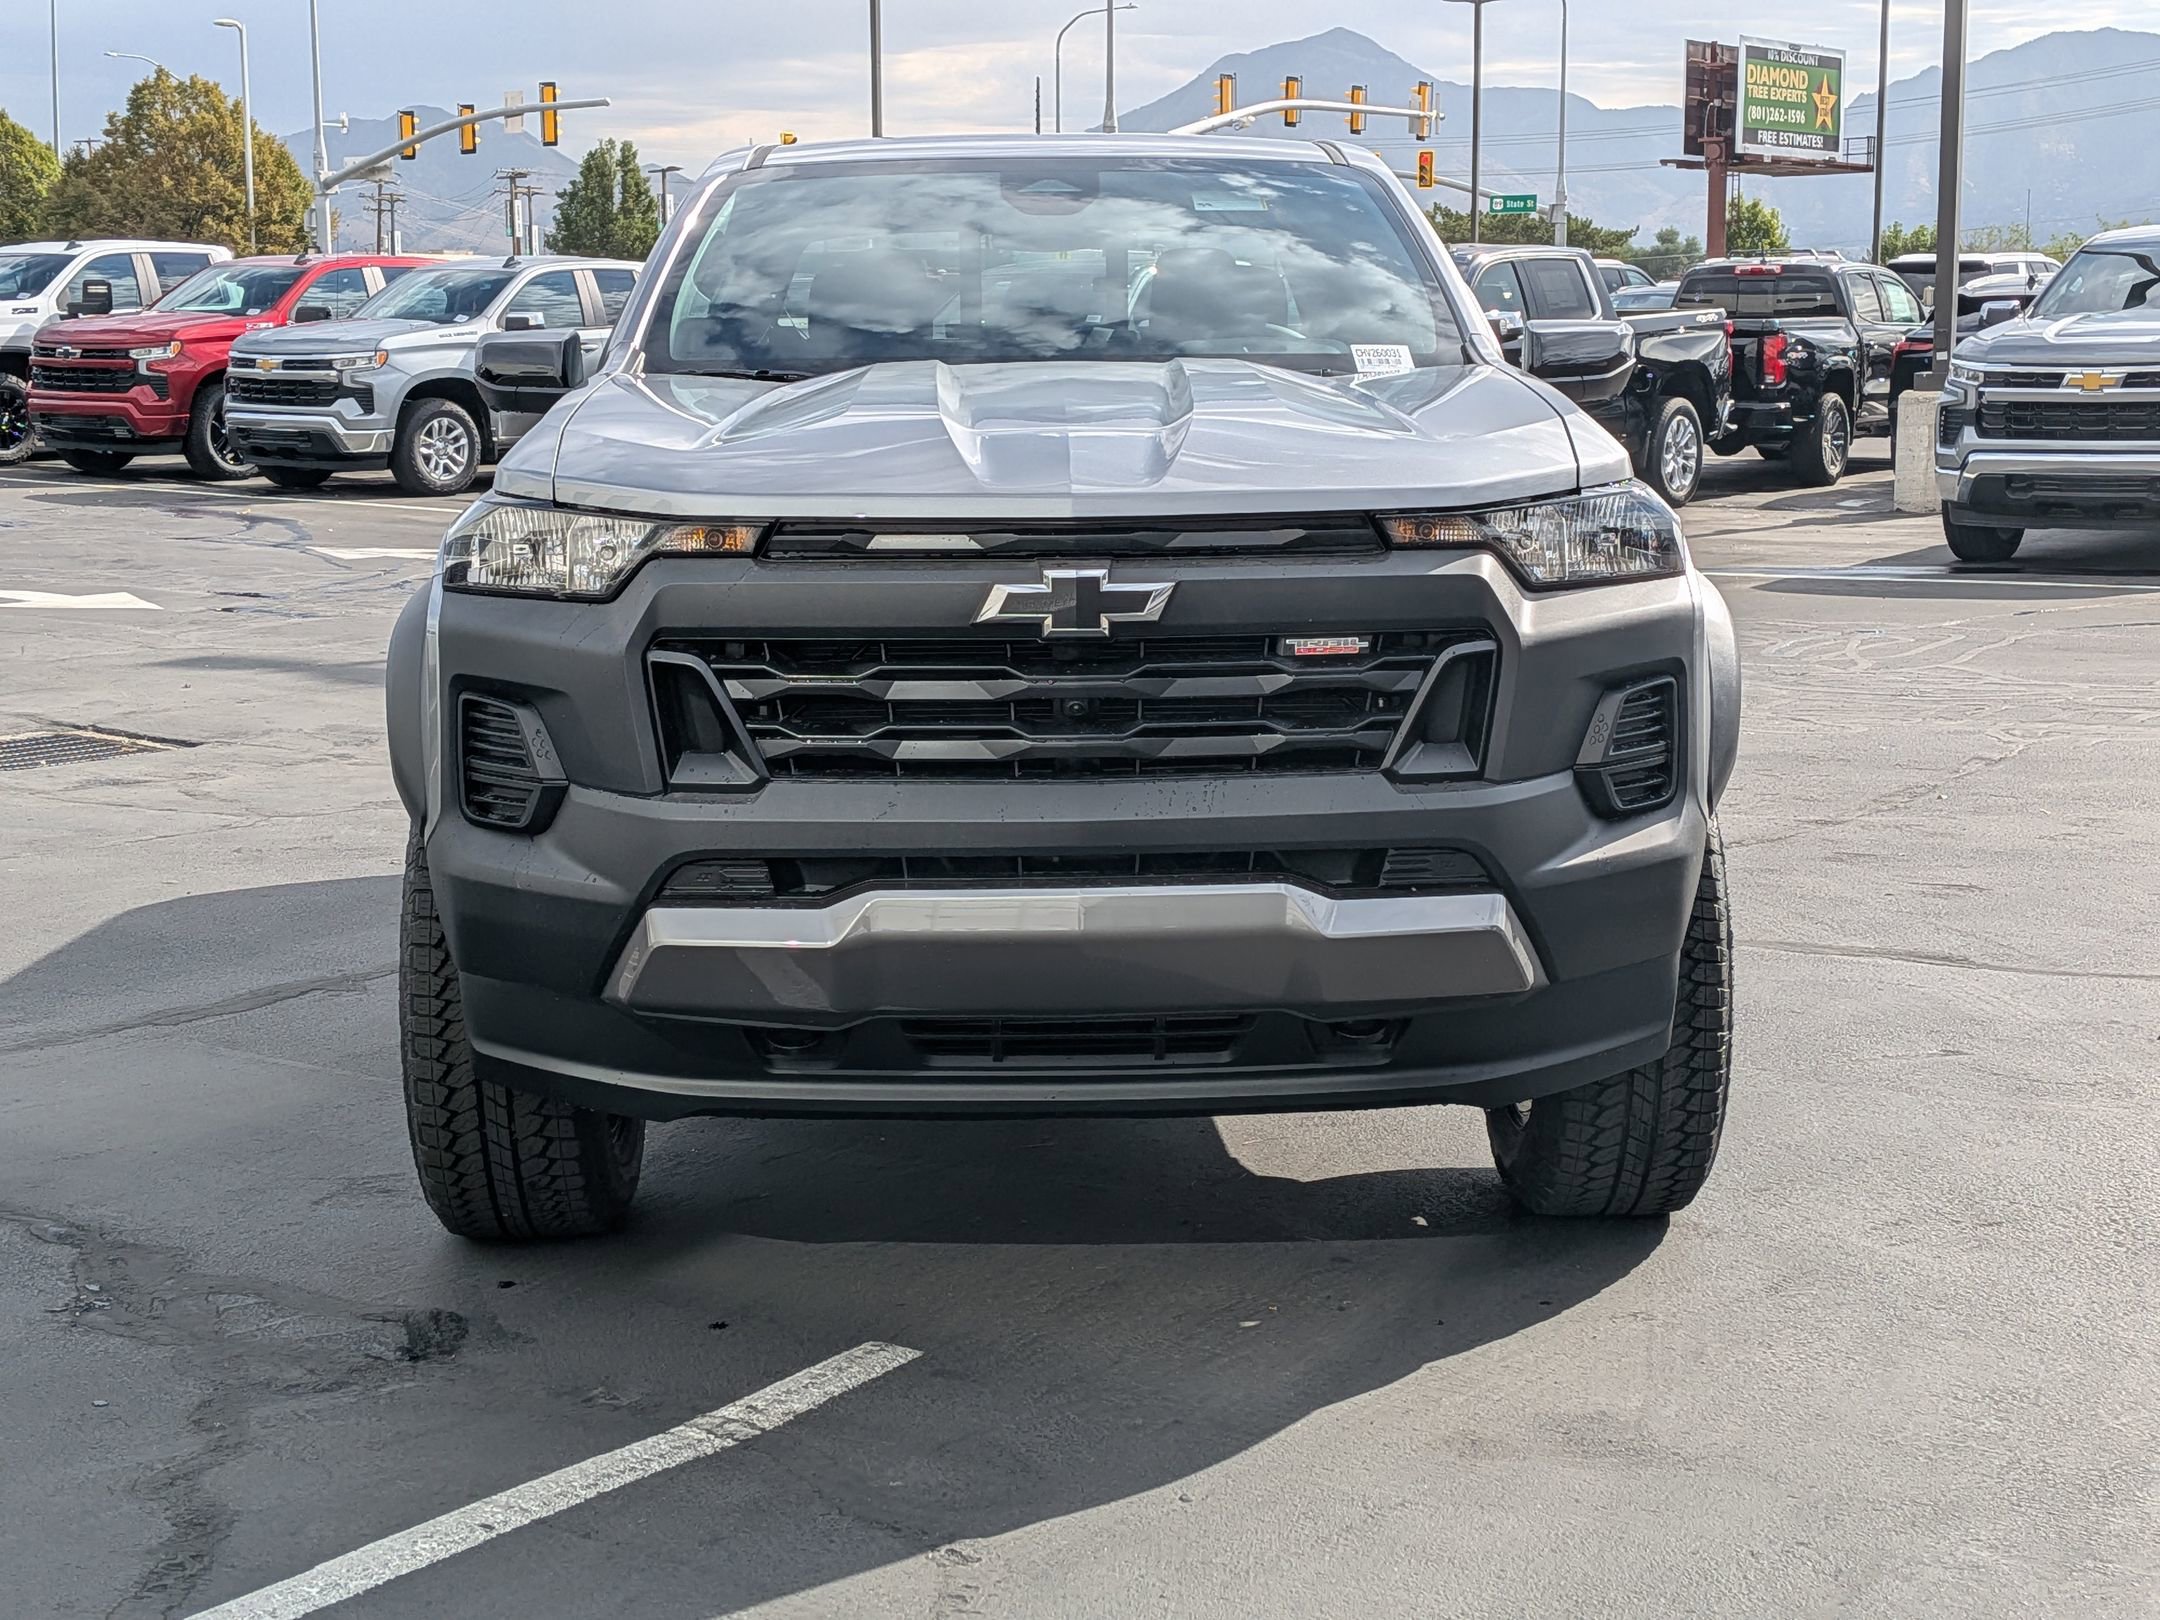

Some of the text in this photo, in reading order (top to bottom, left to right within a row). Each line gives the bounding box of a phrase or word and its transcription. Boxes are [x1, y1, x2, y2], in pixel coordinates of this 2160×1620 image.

[1781, 51, 1819, 66] DISCOUNT
[1747, 64, 1808, 89] DIAMOND
[1747, 85, 1807, 103] TREE EXPERTS
[1748, 105, 1806, 124] (801)262-1596
[1758, 130, 1823, 148] FREE ESTIMATES!
[1506, 199, 1534, 208] State St
[1286, 637, 1368, 648] TRAIL
